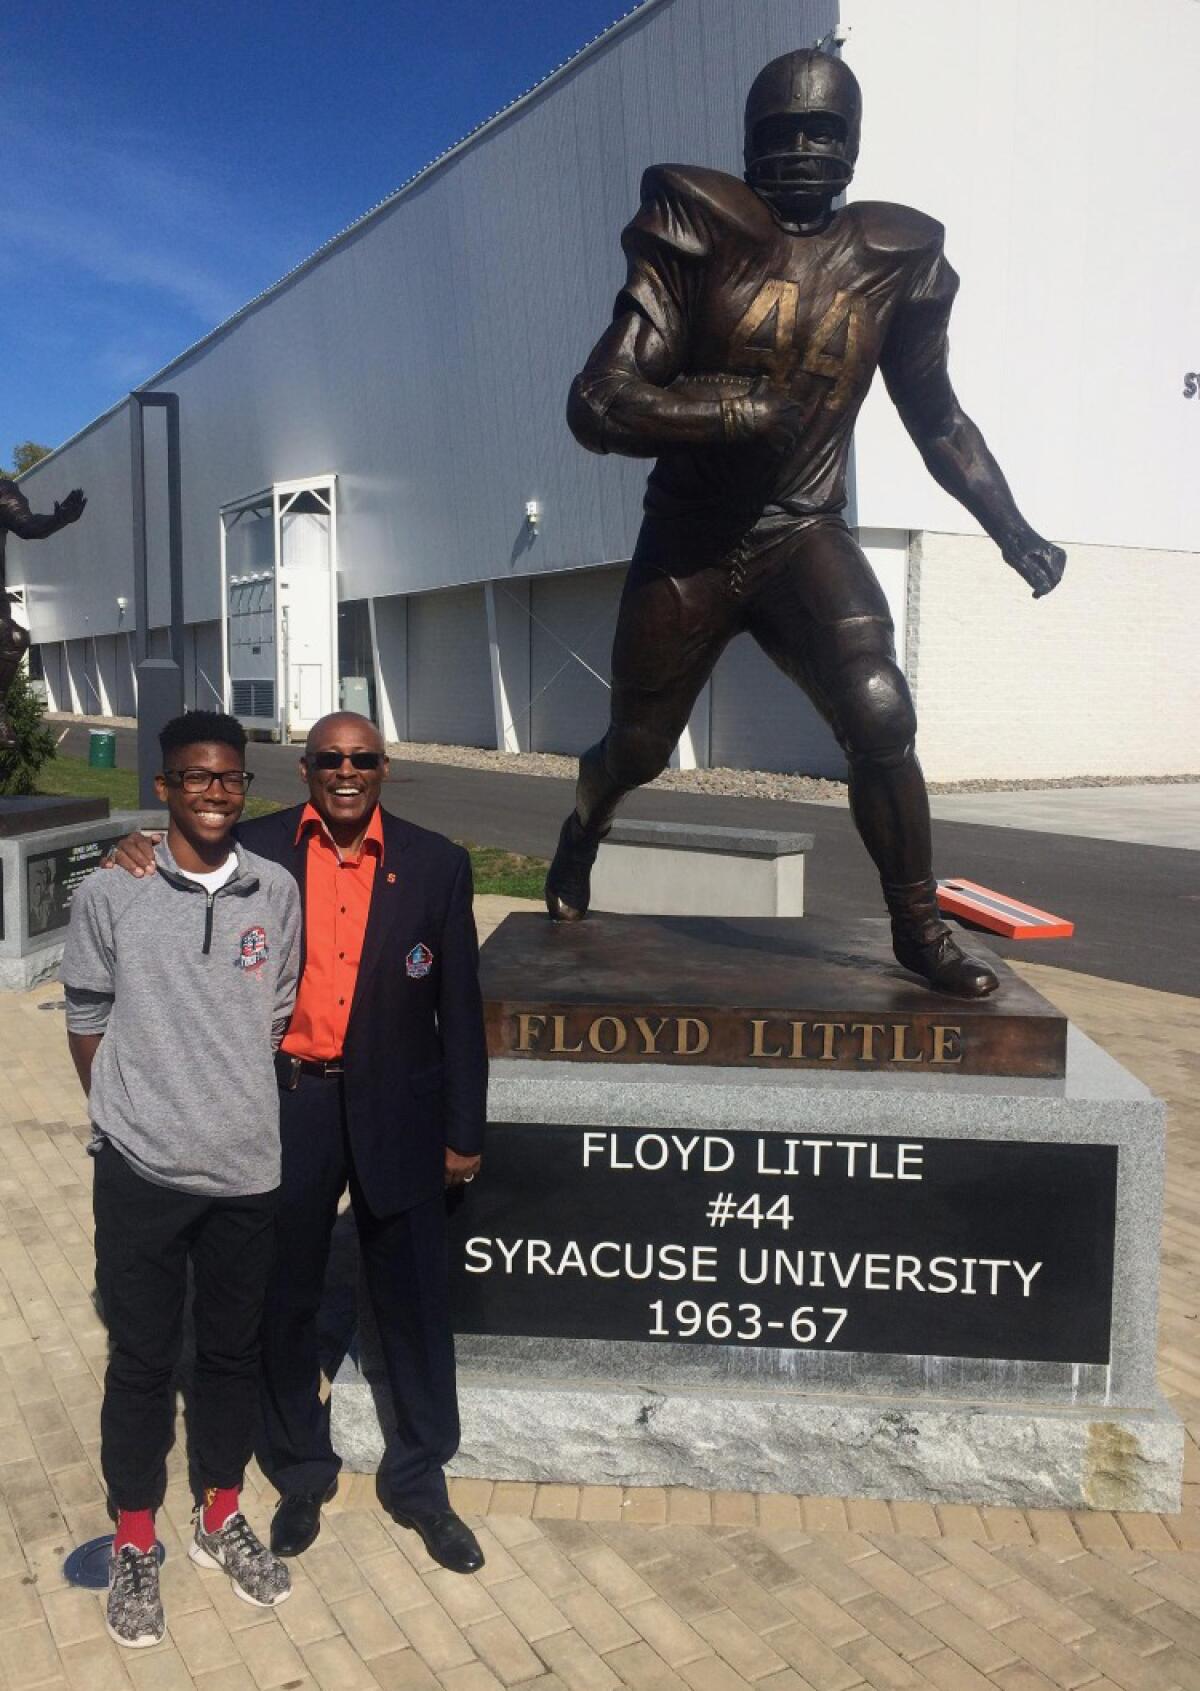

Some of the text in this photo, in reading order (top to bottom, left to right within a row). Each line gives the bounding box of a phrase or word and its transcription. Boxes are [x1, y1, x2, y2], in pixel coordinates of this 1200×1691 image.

[728, 277, 867, 410] 44
[515, 1013, 964, 1064] FLOYD LITTLE
[582, 1132, 925, 1180] FLOYD LITTLE
[705, 1191, 795, 1230] #44
[464, 1236, 1044, 1297] SYRACUSE UNIVERSITY
[648, 1299, 848, 1343] 1963-67
